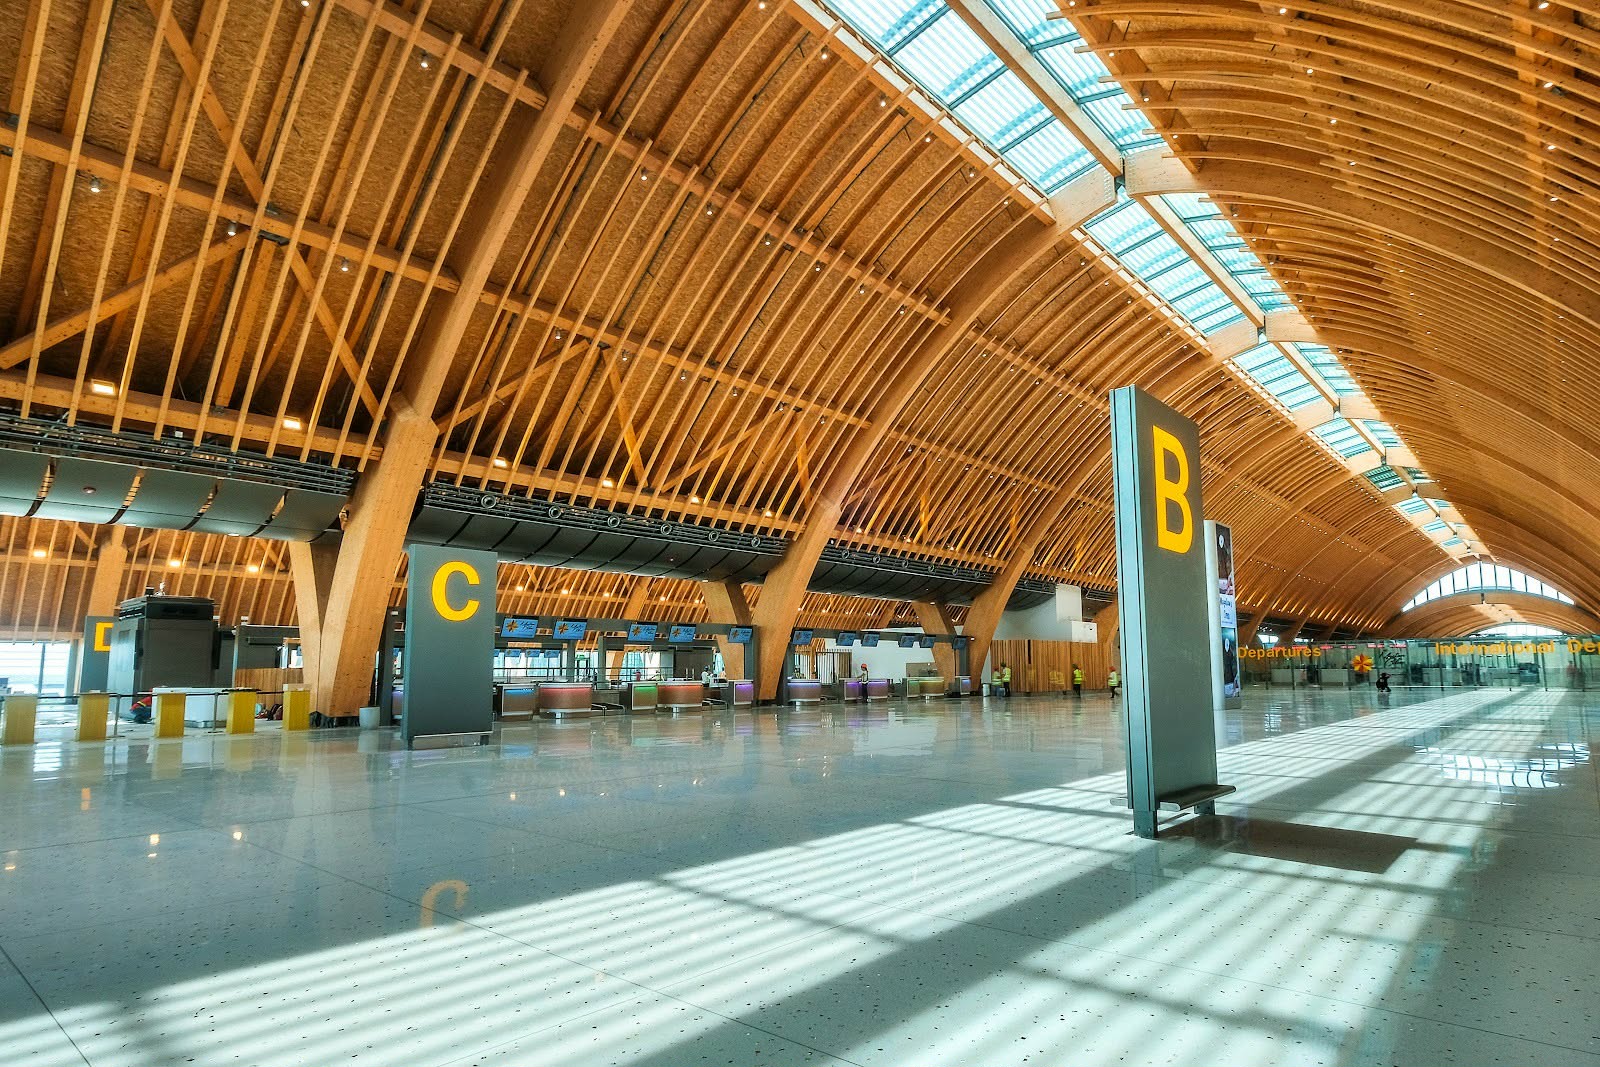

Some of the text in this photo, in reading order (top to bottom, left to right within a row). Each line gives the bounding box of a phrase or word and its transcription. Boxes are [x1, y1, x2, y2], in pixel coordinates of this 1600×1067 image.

[1152, 424, 1193, 554] B
[432, 560, 480, 622] C
[1238, 646, 1322, 660] Departures
[1435, 639, 1600, 655] International De
